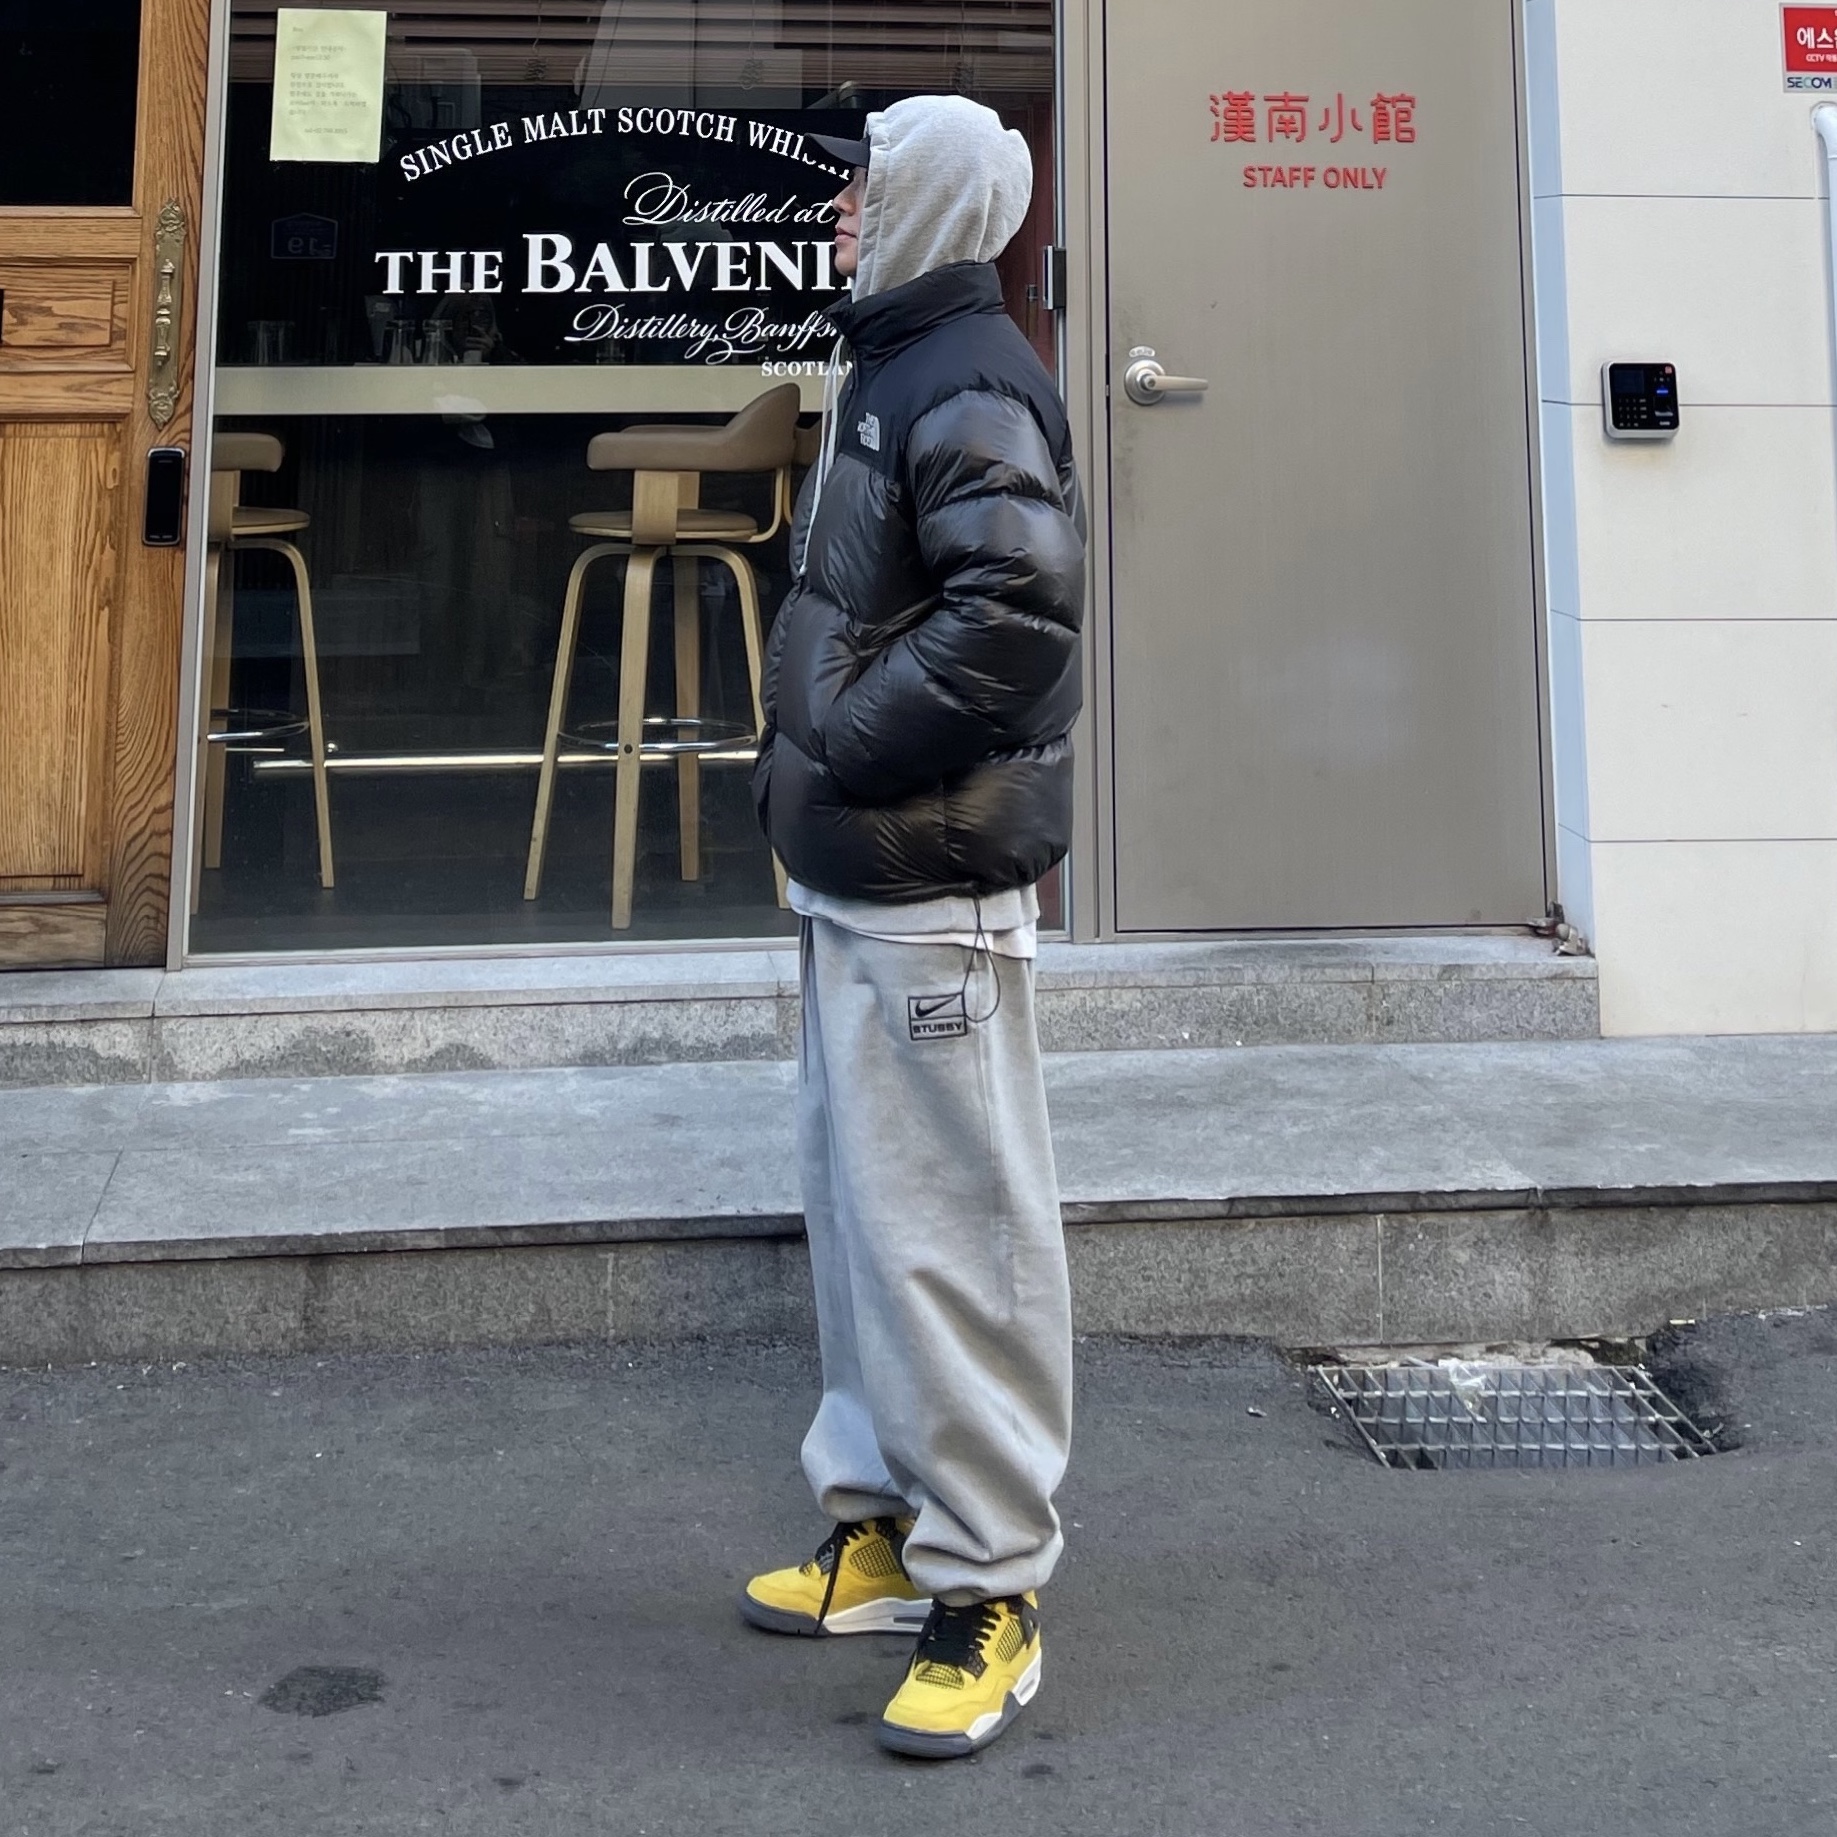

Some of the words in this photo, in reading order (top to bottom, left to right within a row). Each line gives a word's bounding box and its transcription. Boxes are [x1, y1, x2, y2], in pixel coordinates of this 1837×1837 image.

[1796, 26, 1837, 49] 에스
[1787, 76, 1832, 89] SECOM
[1209, 90, 1417, 144] 漢南小館
[400, 121, 513, 182] SINGLE
[521, 108, 606, 144] MALT
[617, 107, 738, 143] SCOTCH
[748, 120, 850, 181] WHI
[621, 171, 791, 226] Distilled
[792, 198, 836, 224] at
[1242, 165, 1316, 189] STAFF
[1322, 166, 1388, 189] ONLY
[374, 251, 504, 294] THE
[521, 233, 853, 293] BALVENI
[563, 303, 719, 360] Distillery,
